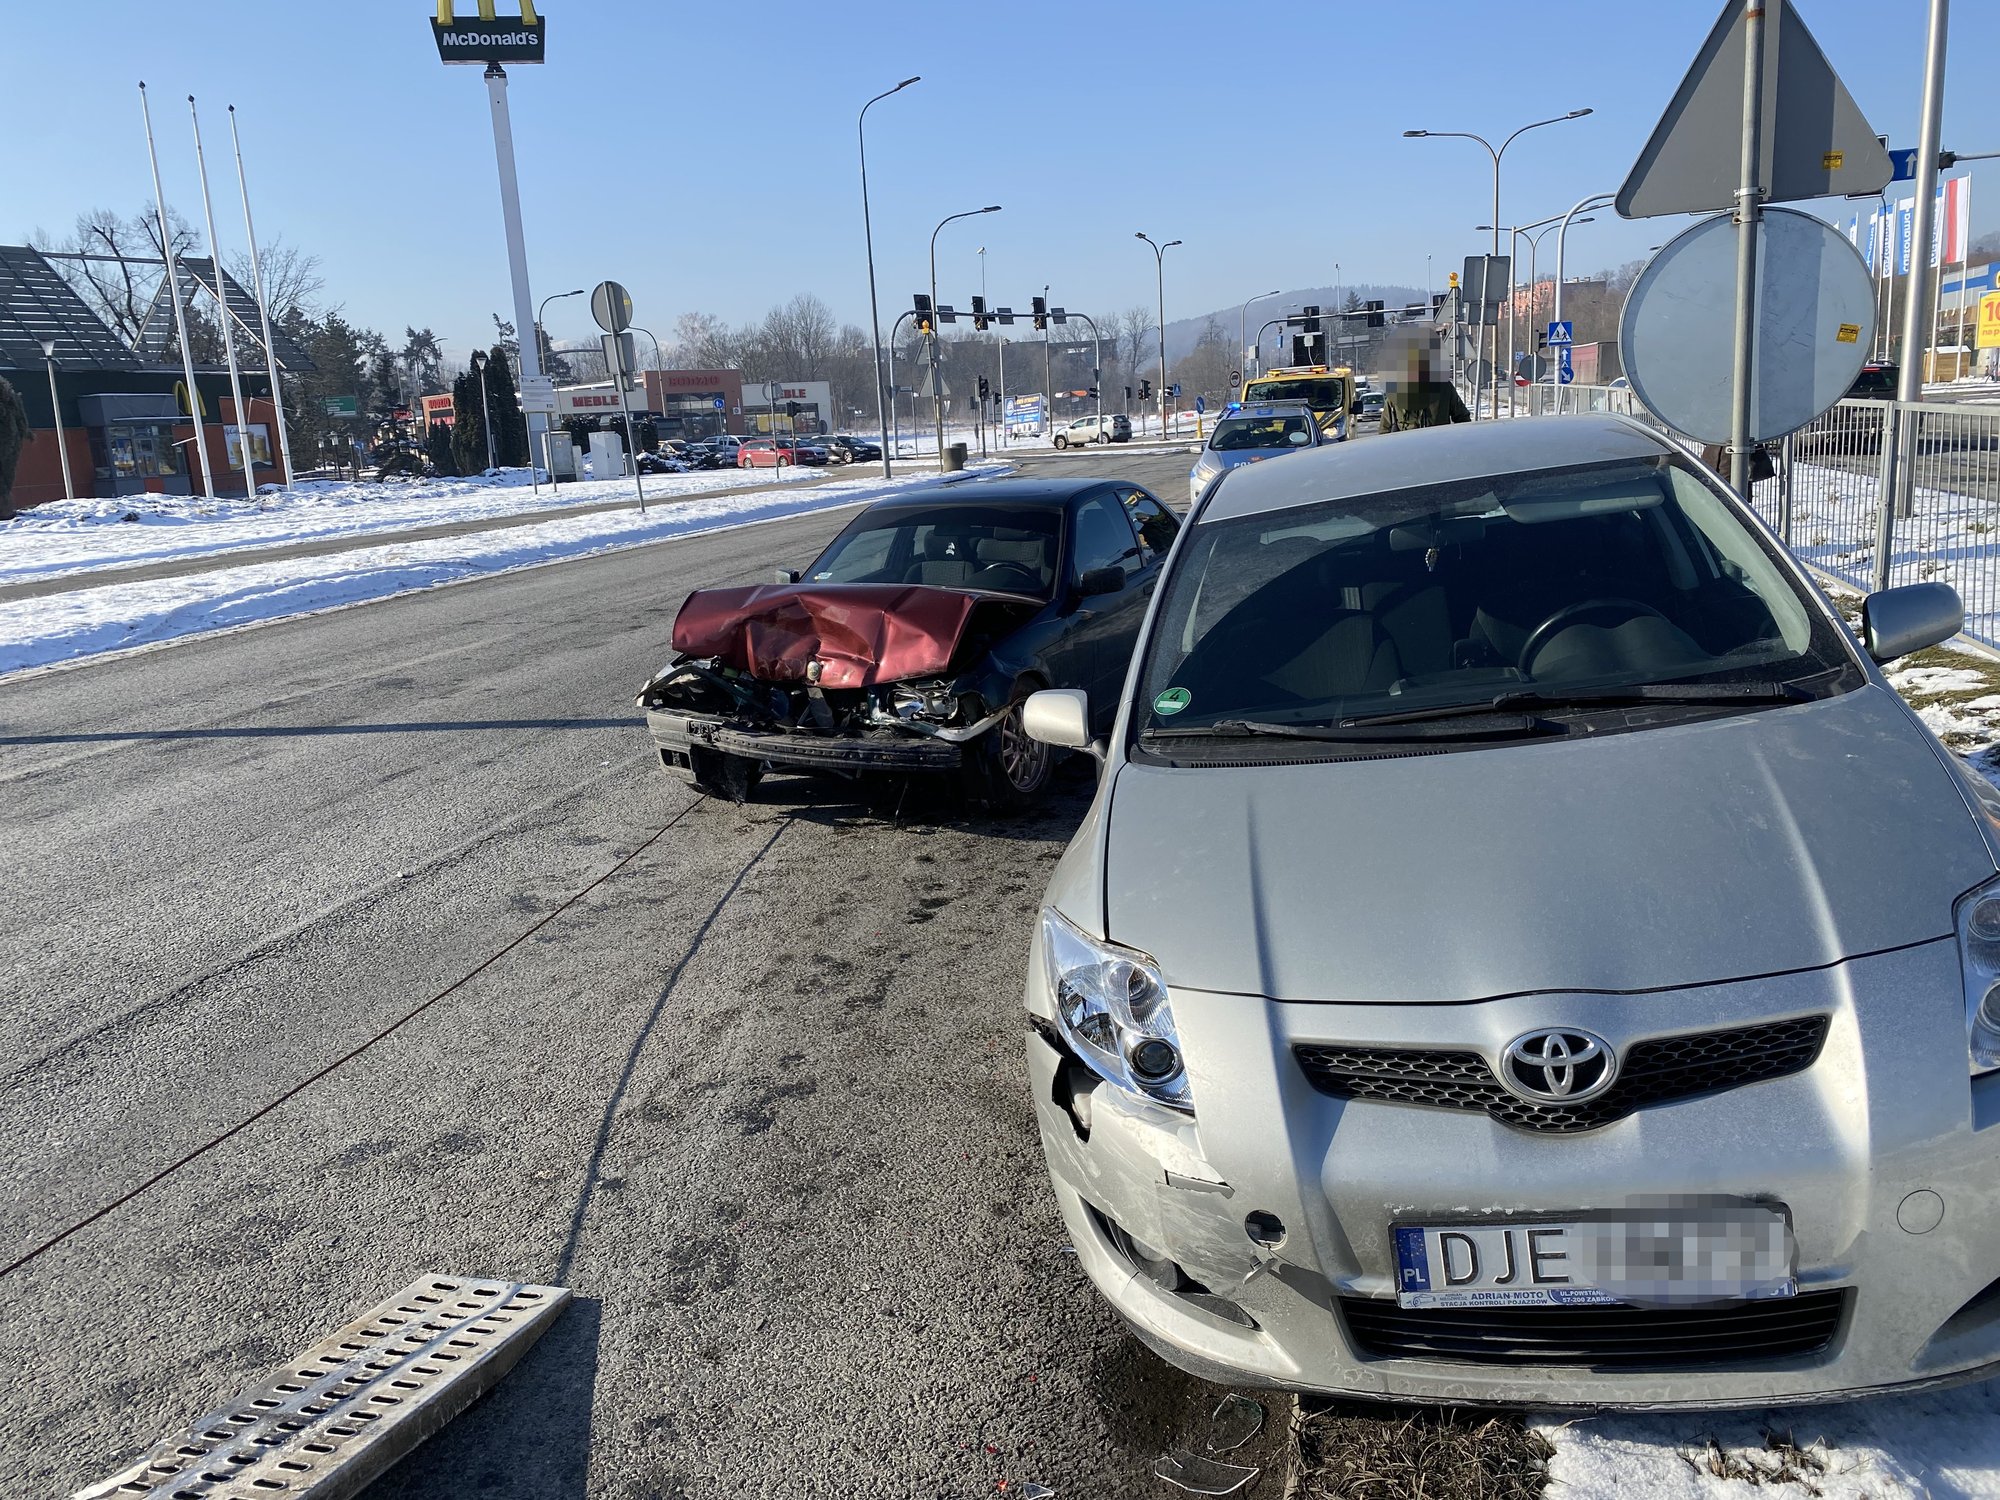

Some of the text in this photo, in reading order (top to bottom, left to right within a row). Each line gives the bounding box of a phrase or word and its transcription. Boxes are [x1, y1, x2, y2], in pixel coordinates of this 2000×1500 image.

[442, 32, 539, 46] McDonald's
[572, 394, 619, 407] MEBLE
[1169, 689, 1180, 701] 4
[1438, 1229, 1570, 1286] DJE
[1403, 1268, 1425, 1283] PL
[1471, 1291, 1544, 1300] ADRIAN-MOTO
